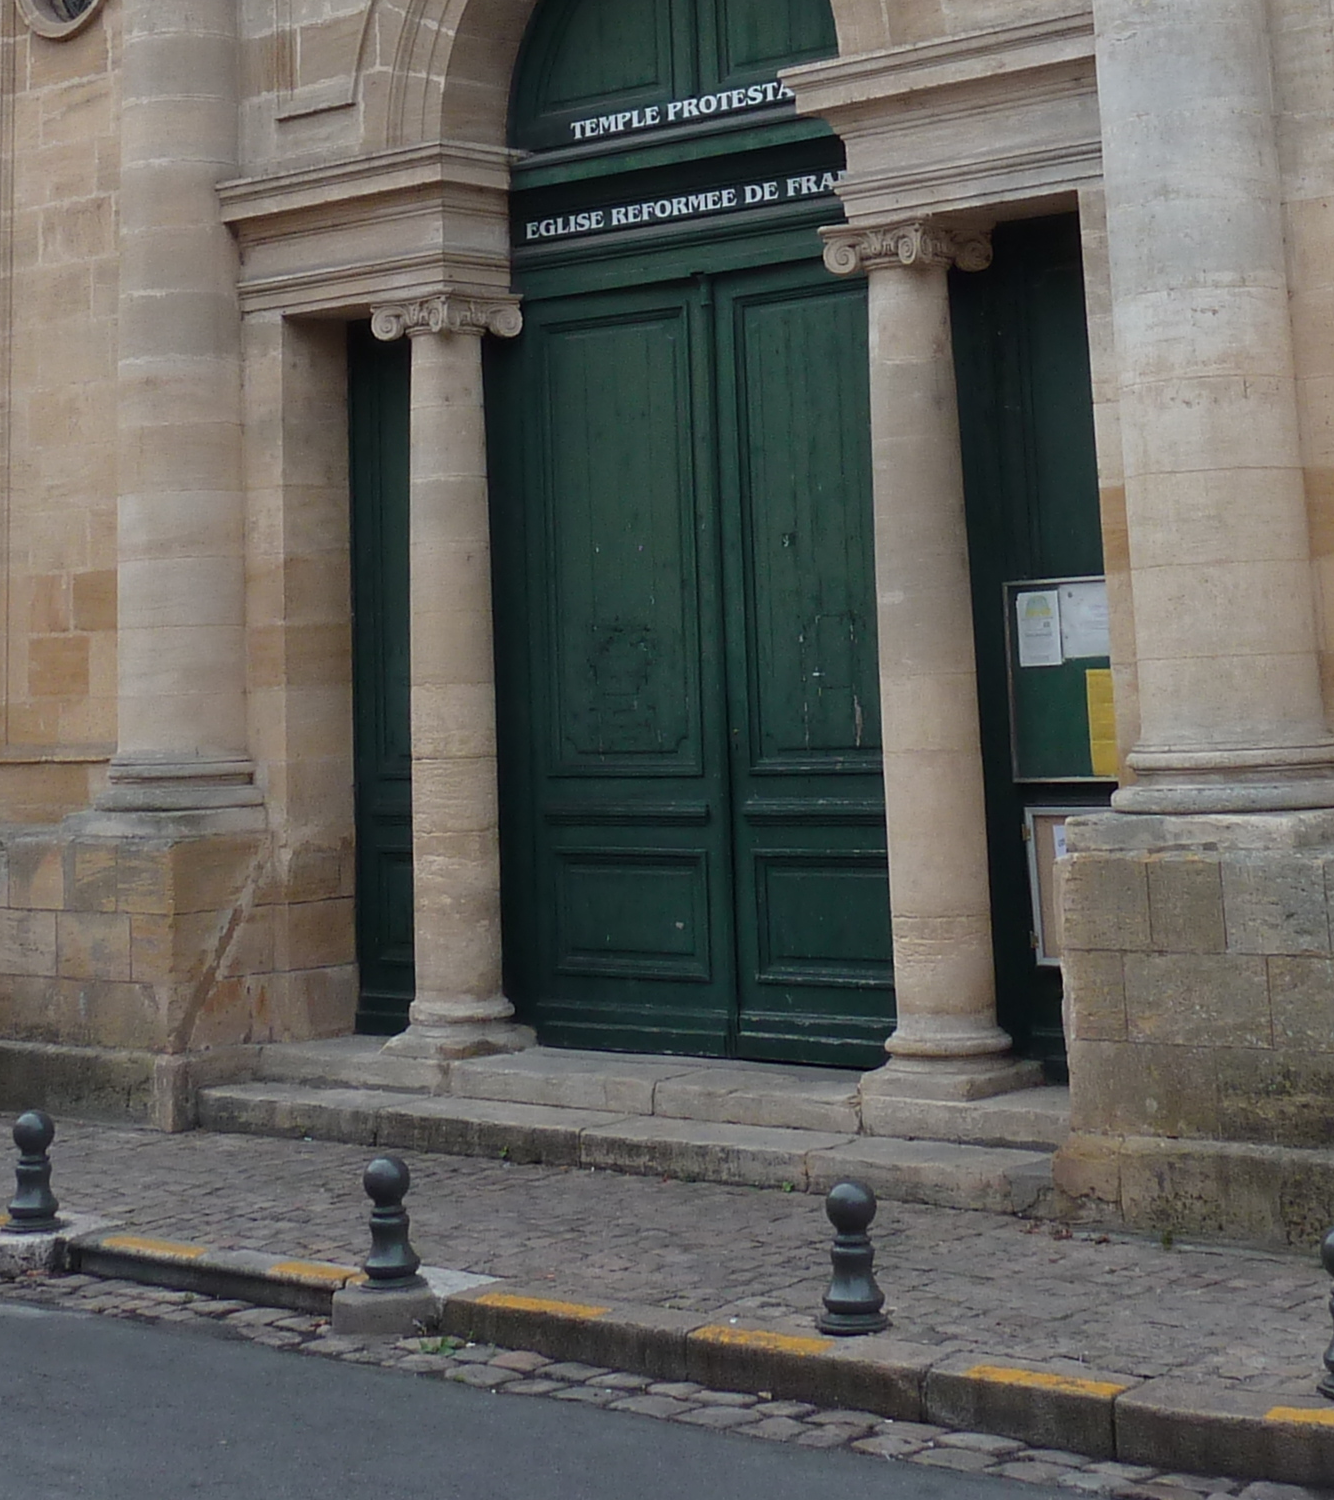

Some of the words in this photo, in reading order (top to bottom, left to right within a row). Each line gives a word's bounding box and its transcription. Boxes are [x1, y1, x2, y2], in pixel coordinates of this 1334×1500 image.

[570, 106, 659, 140] TEMPLE
[526, 211, 605, 239] EGLISE
[611, 188, 738, 226] REFORMEE
[744, 181, 779, 205] DE
